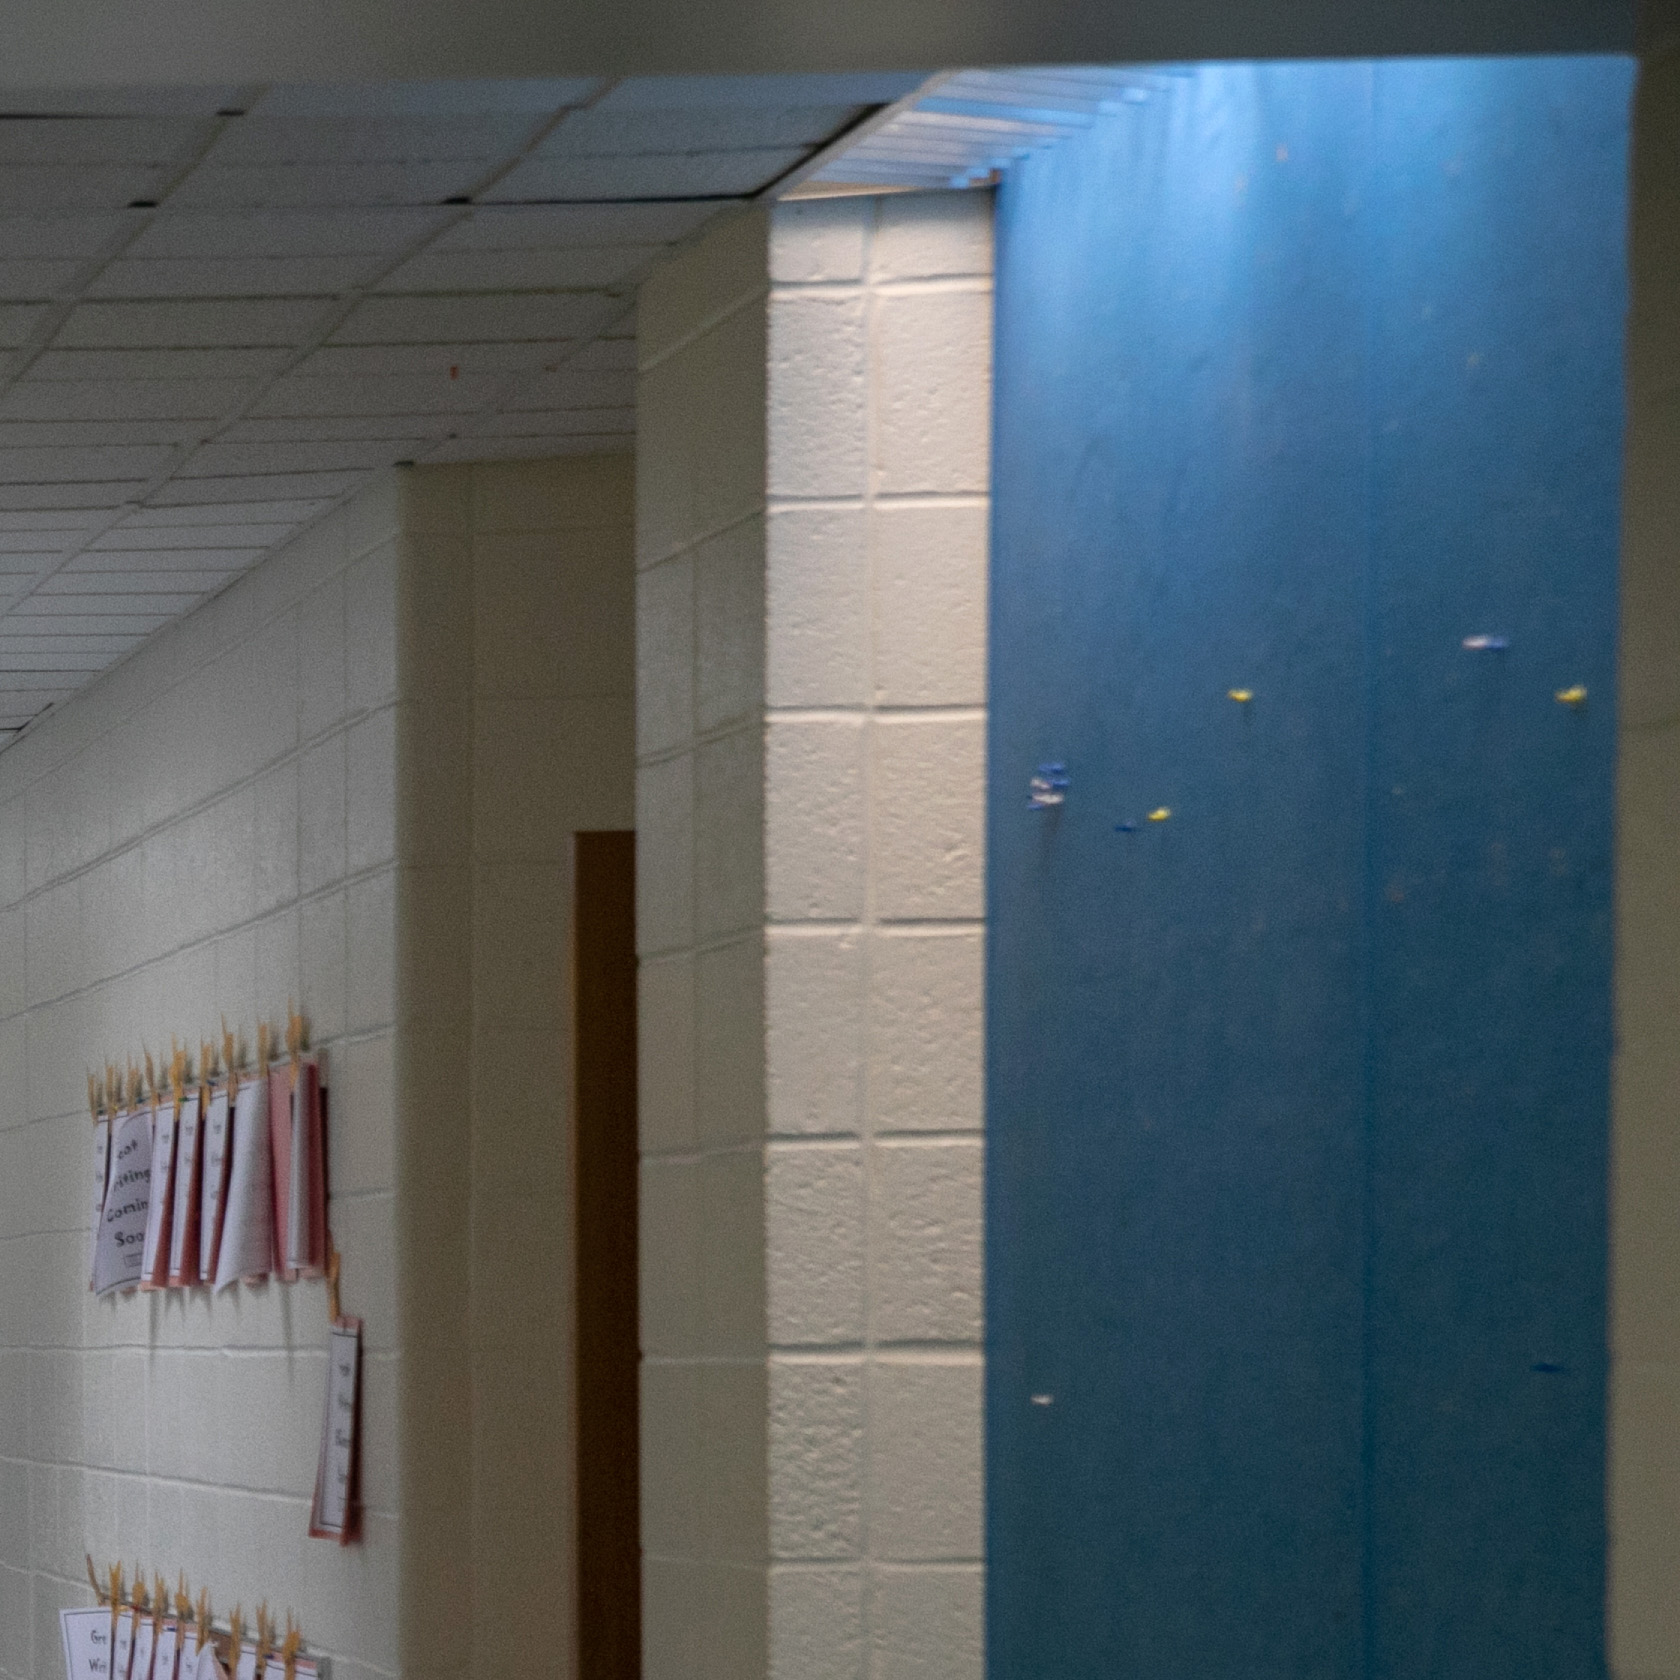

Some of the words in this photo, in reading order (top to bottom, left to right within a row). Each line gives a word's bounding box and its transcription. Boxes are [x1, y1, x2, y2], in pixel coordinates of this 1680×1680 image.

[113, 1168, 150, 1192] riting
[107, 1198, 149, 1223] Comin
[114, 1231, 145, 1248] Soo
